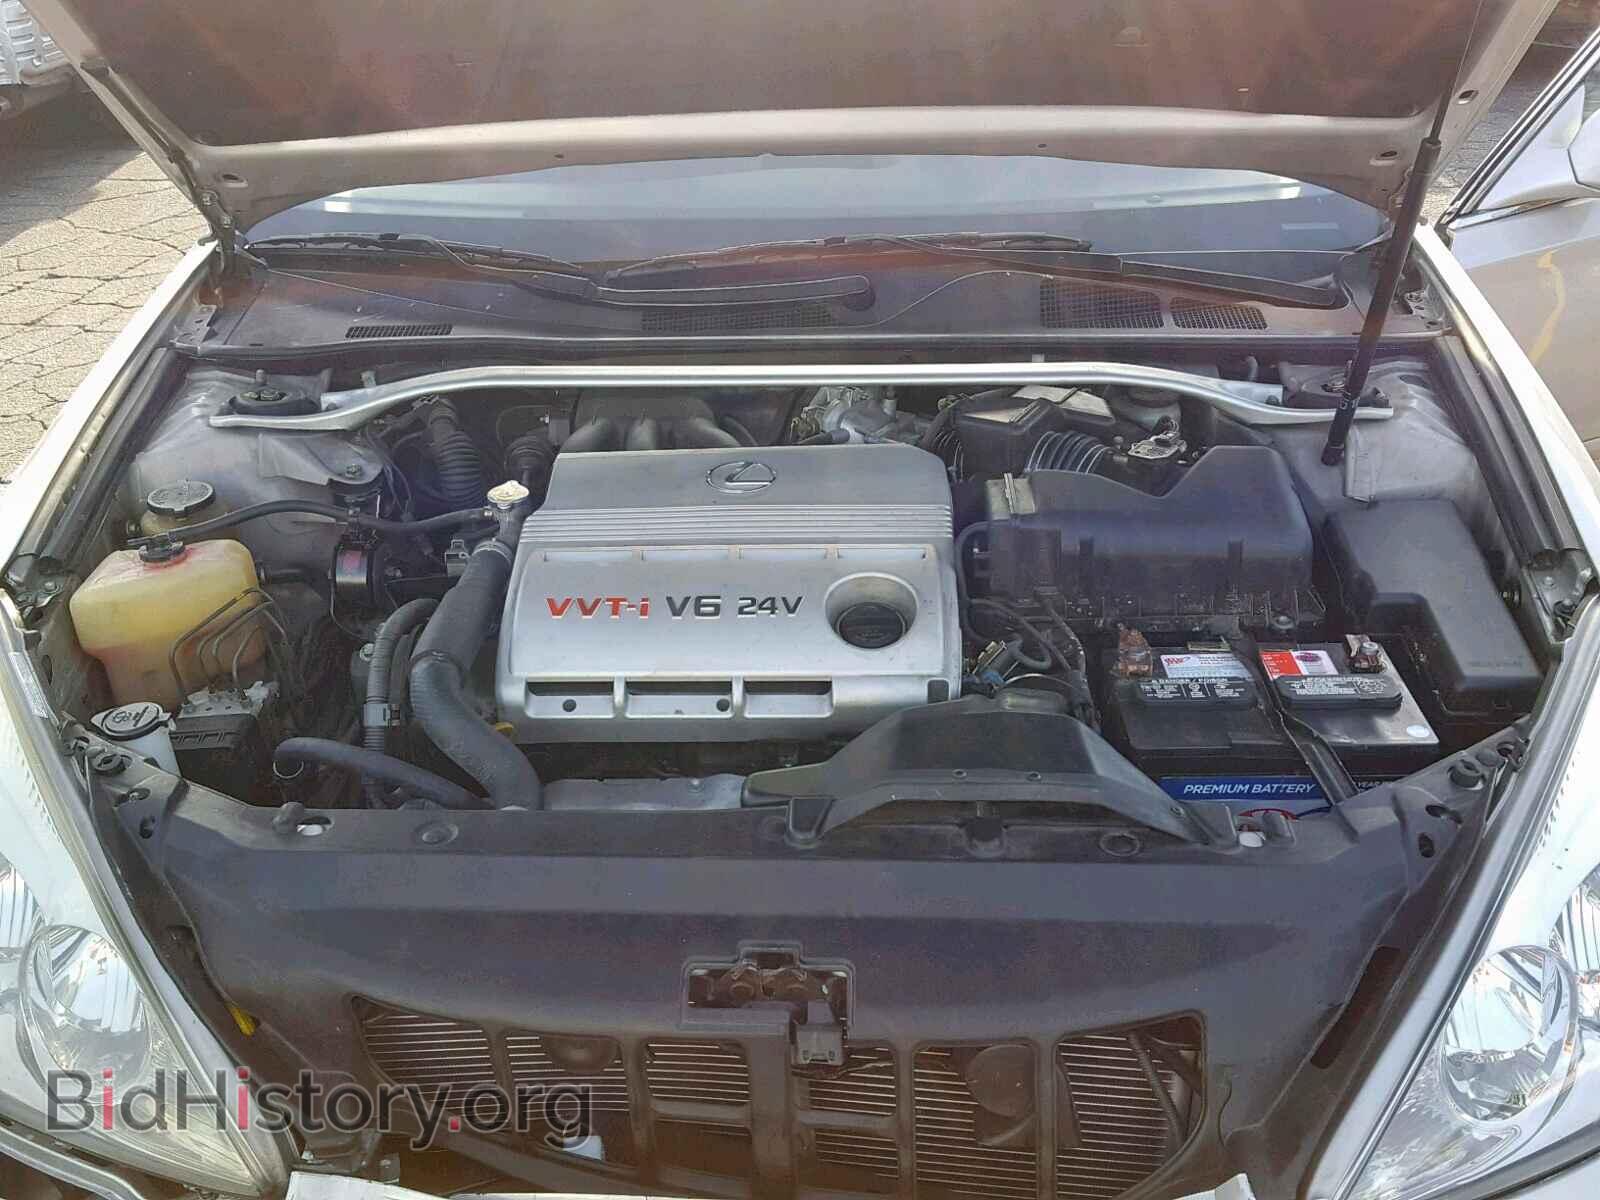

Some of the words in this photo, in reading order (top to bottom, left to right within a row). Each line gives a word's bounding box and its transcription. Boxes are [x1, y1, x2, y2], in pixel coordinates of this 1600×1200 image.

[547, 597, 649, 619] VVT-i
[666, 595, 722, 619] V6
[737, 596, 803, 618] 24V
[1183, 783, 1250, 794] PREMIUM
[1252, 783, 1316, 793] BATTERY
